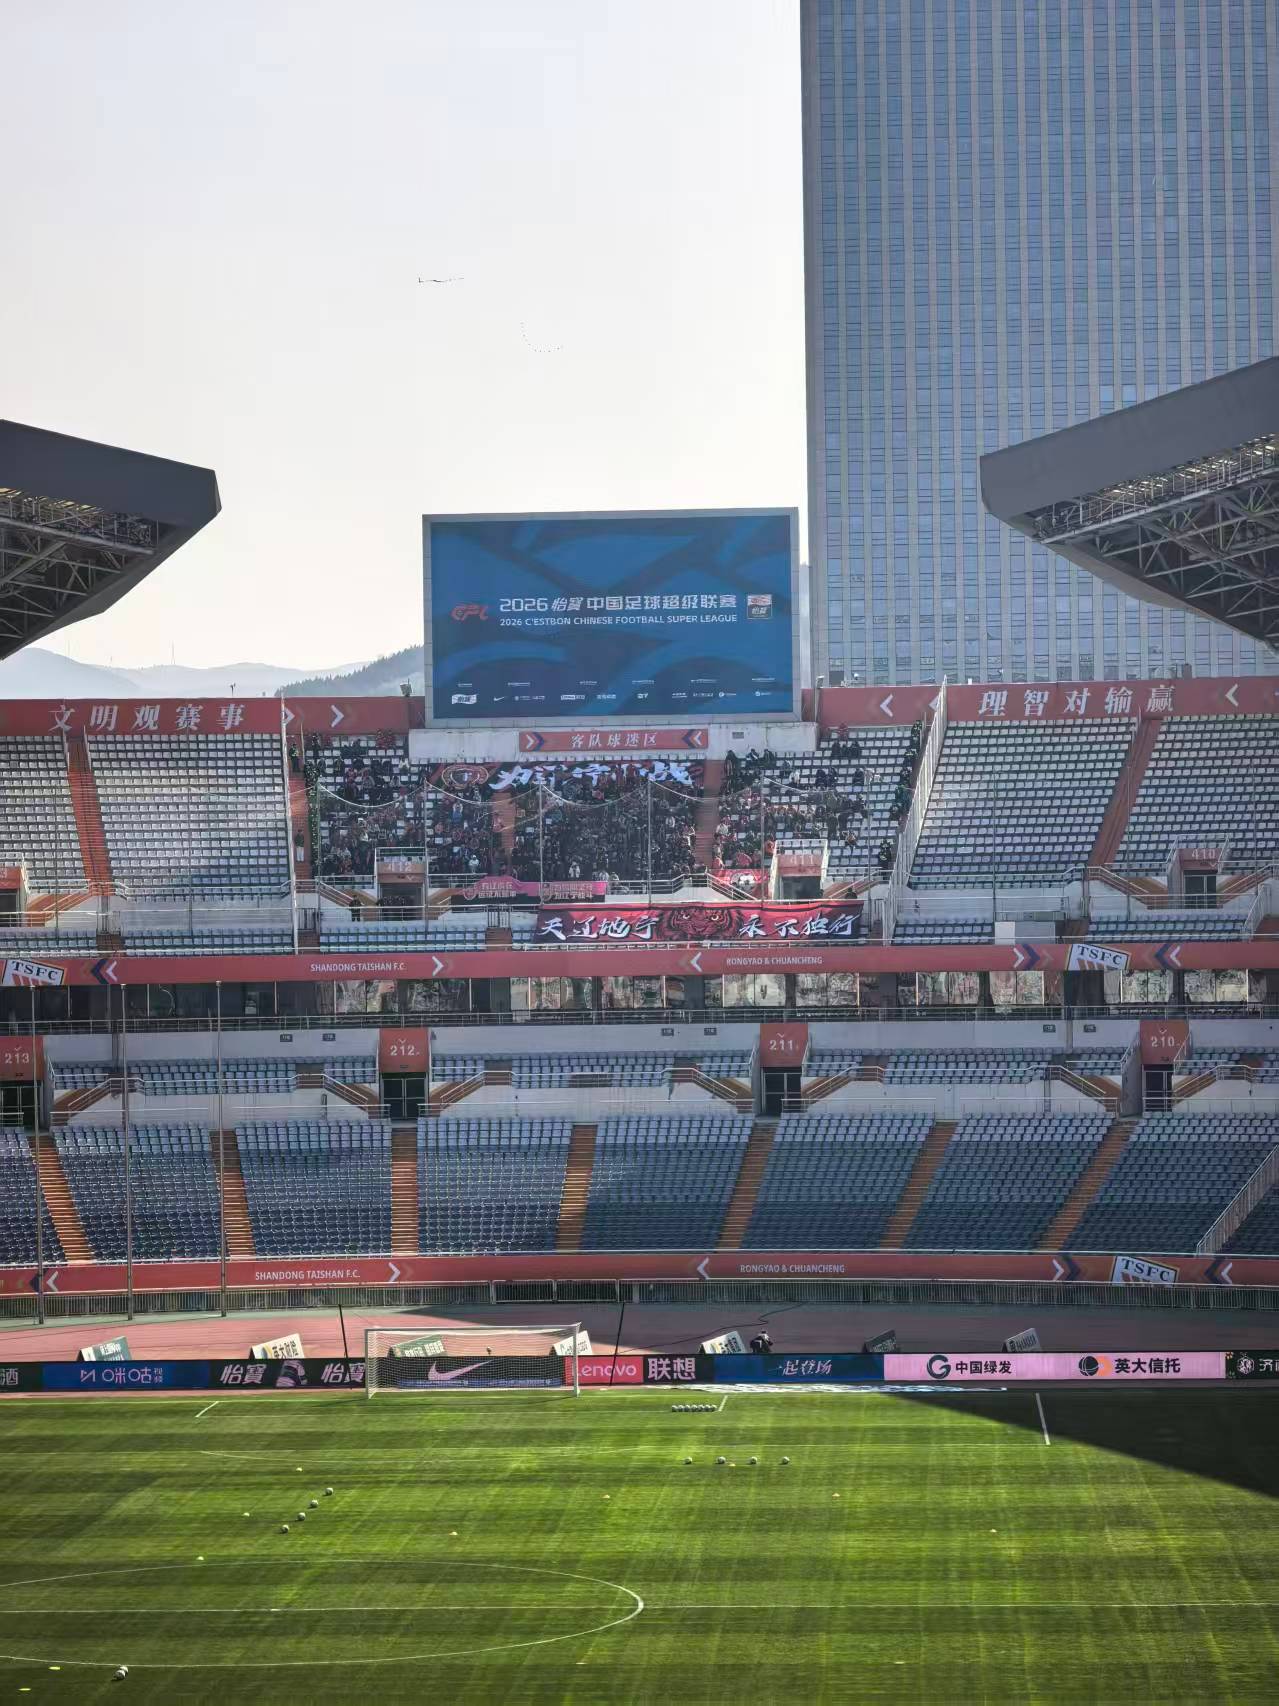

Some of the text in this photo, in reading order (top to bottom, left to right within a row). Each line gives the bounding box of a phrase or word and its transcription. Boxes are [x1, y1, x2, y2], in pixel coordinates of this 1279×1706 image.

[500, 598, 548, 612] 2026
[587, 594, 737, 611] 中国足球超级联赛
[500, 614, 737, 626] 2026 C'ESTBON CHINESE FOOTBALL SUPER LEAGUE
[978, 684, 1175, 717] 理智对输赢
[48, 703, 245, 732] 文明观赛事
[569, 732, 658, 748] 客队球迷区
[1191, 849, 1216, 860] 410
[537, 913, 860, 941] 天辽地宁 永不独行
[726, 956, 763, 966] RONGYAO
[771, 956, 823, 965] CHUANCHENG
[1078, 945, 1122, 965] TSFC
[12, 960, 58, 981] TSFC
[310, 963, 356, 972] SHANDONG
[358, 962, 392, 971] TAISHAN
[769, 1039, 793, 1051] 211
[1151, 1035, 1175, 1047] 210
[5, 1052, 30, 1064] 213
[255, 1269, 361, 1281] SHANDONG TAISHAN F.C.
[740, 1264, 846, 1273] RONGYAO & CHUANCHENG
[1121, 1258, 1170, 1282] TSFC
[647, 1358, 697, 1380] 联想
[955, 1361, 1012, 1374] 中国绿发
[1114, 1358, 1181, 1374] 英大信托
[102, 1367, 151, 1384] 咪咕
